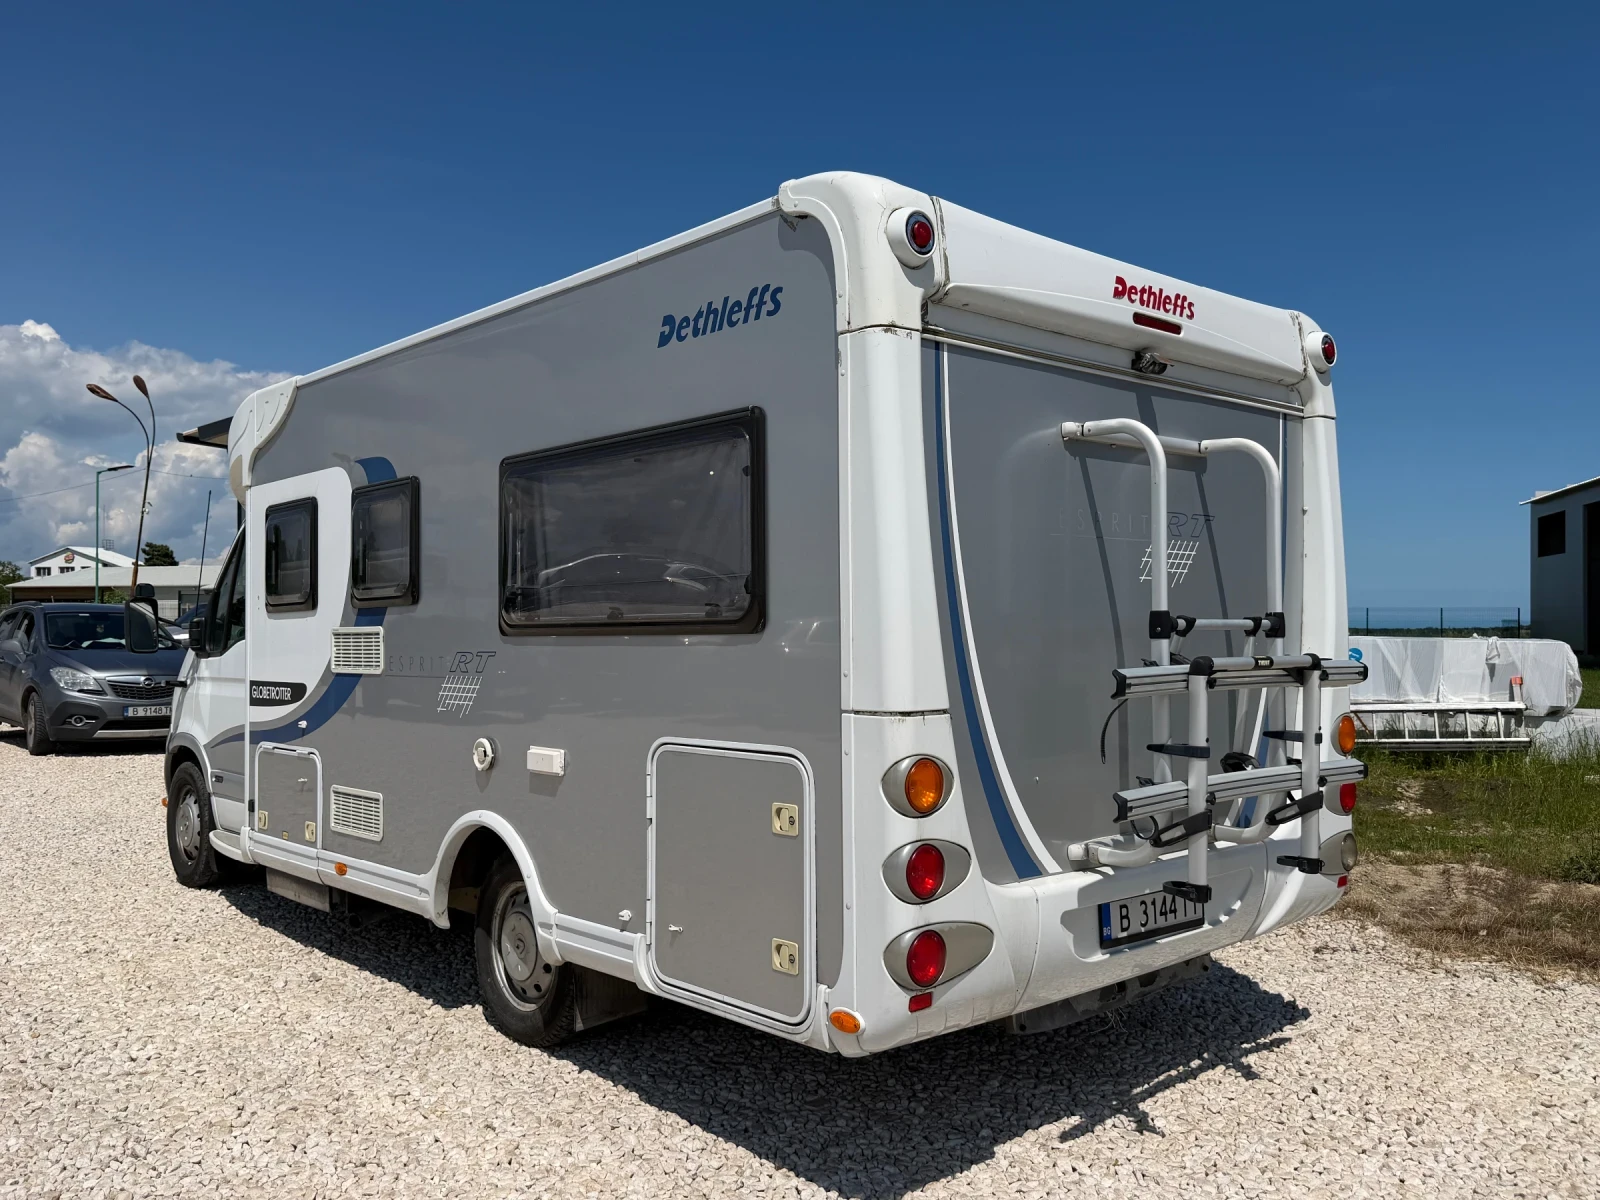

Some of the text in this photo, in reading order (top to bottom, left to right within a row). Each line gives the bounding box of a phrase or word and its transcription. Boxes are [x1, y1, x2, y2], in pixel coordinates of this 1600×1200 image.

[1112, 275, 1195, 320] Dethleffs
[657, 283, 784, 348] Dethleffs
[1167, 511, 1215, 538] RT
[388, 651, 497, 673] ESPRIT RT
[251, 685, 292, 701] GLOBETROTTER
[132, 707, 138, 716] B
[142, 706, 163, 716] 9148
[1119, 903, 1131, 933] B
[1139, 894, 1178, 928] 3144
[1103, 926, 1111, 936] BG
